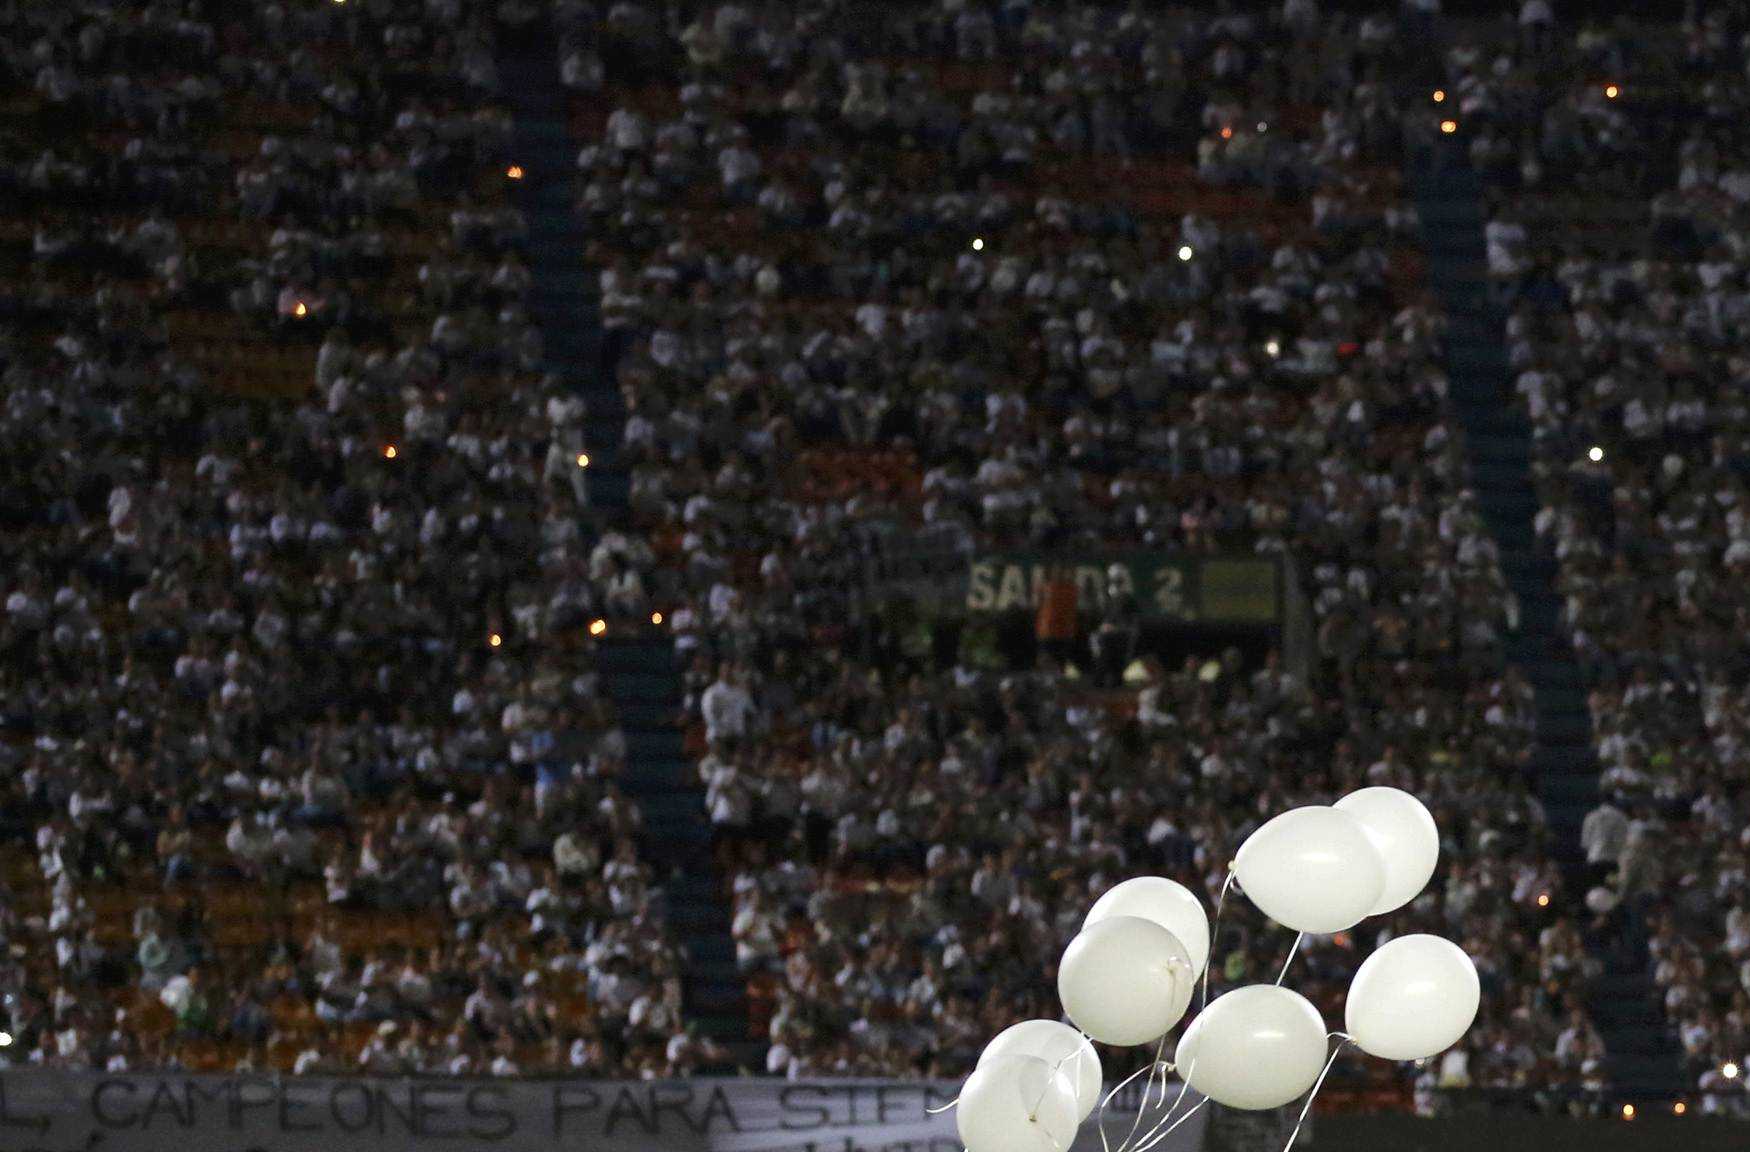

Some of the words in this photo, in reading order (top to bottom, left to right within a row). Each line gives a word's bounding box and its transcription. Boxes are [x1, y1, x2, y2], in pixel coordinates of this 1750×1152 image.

[1152, 567, 1184, 613] 2
[92, 1080, 516, 1140] CAMPEONES
[553, 1083, 738, 1137] PARA
